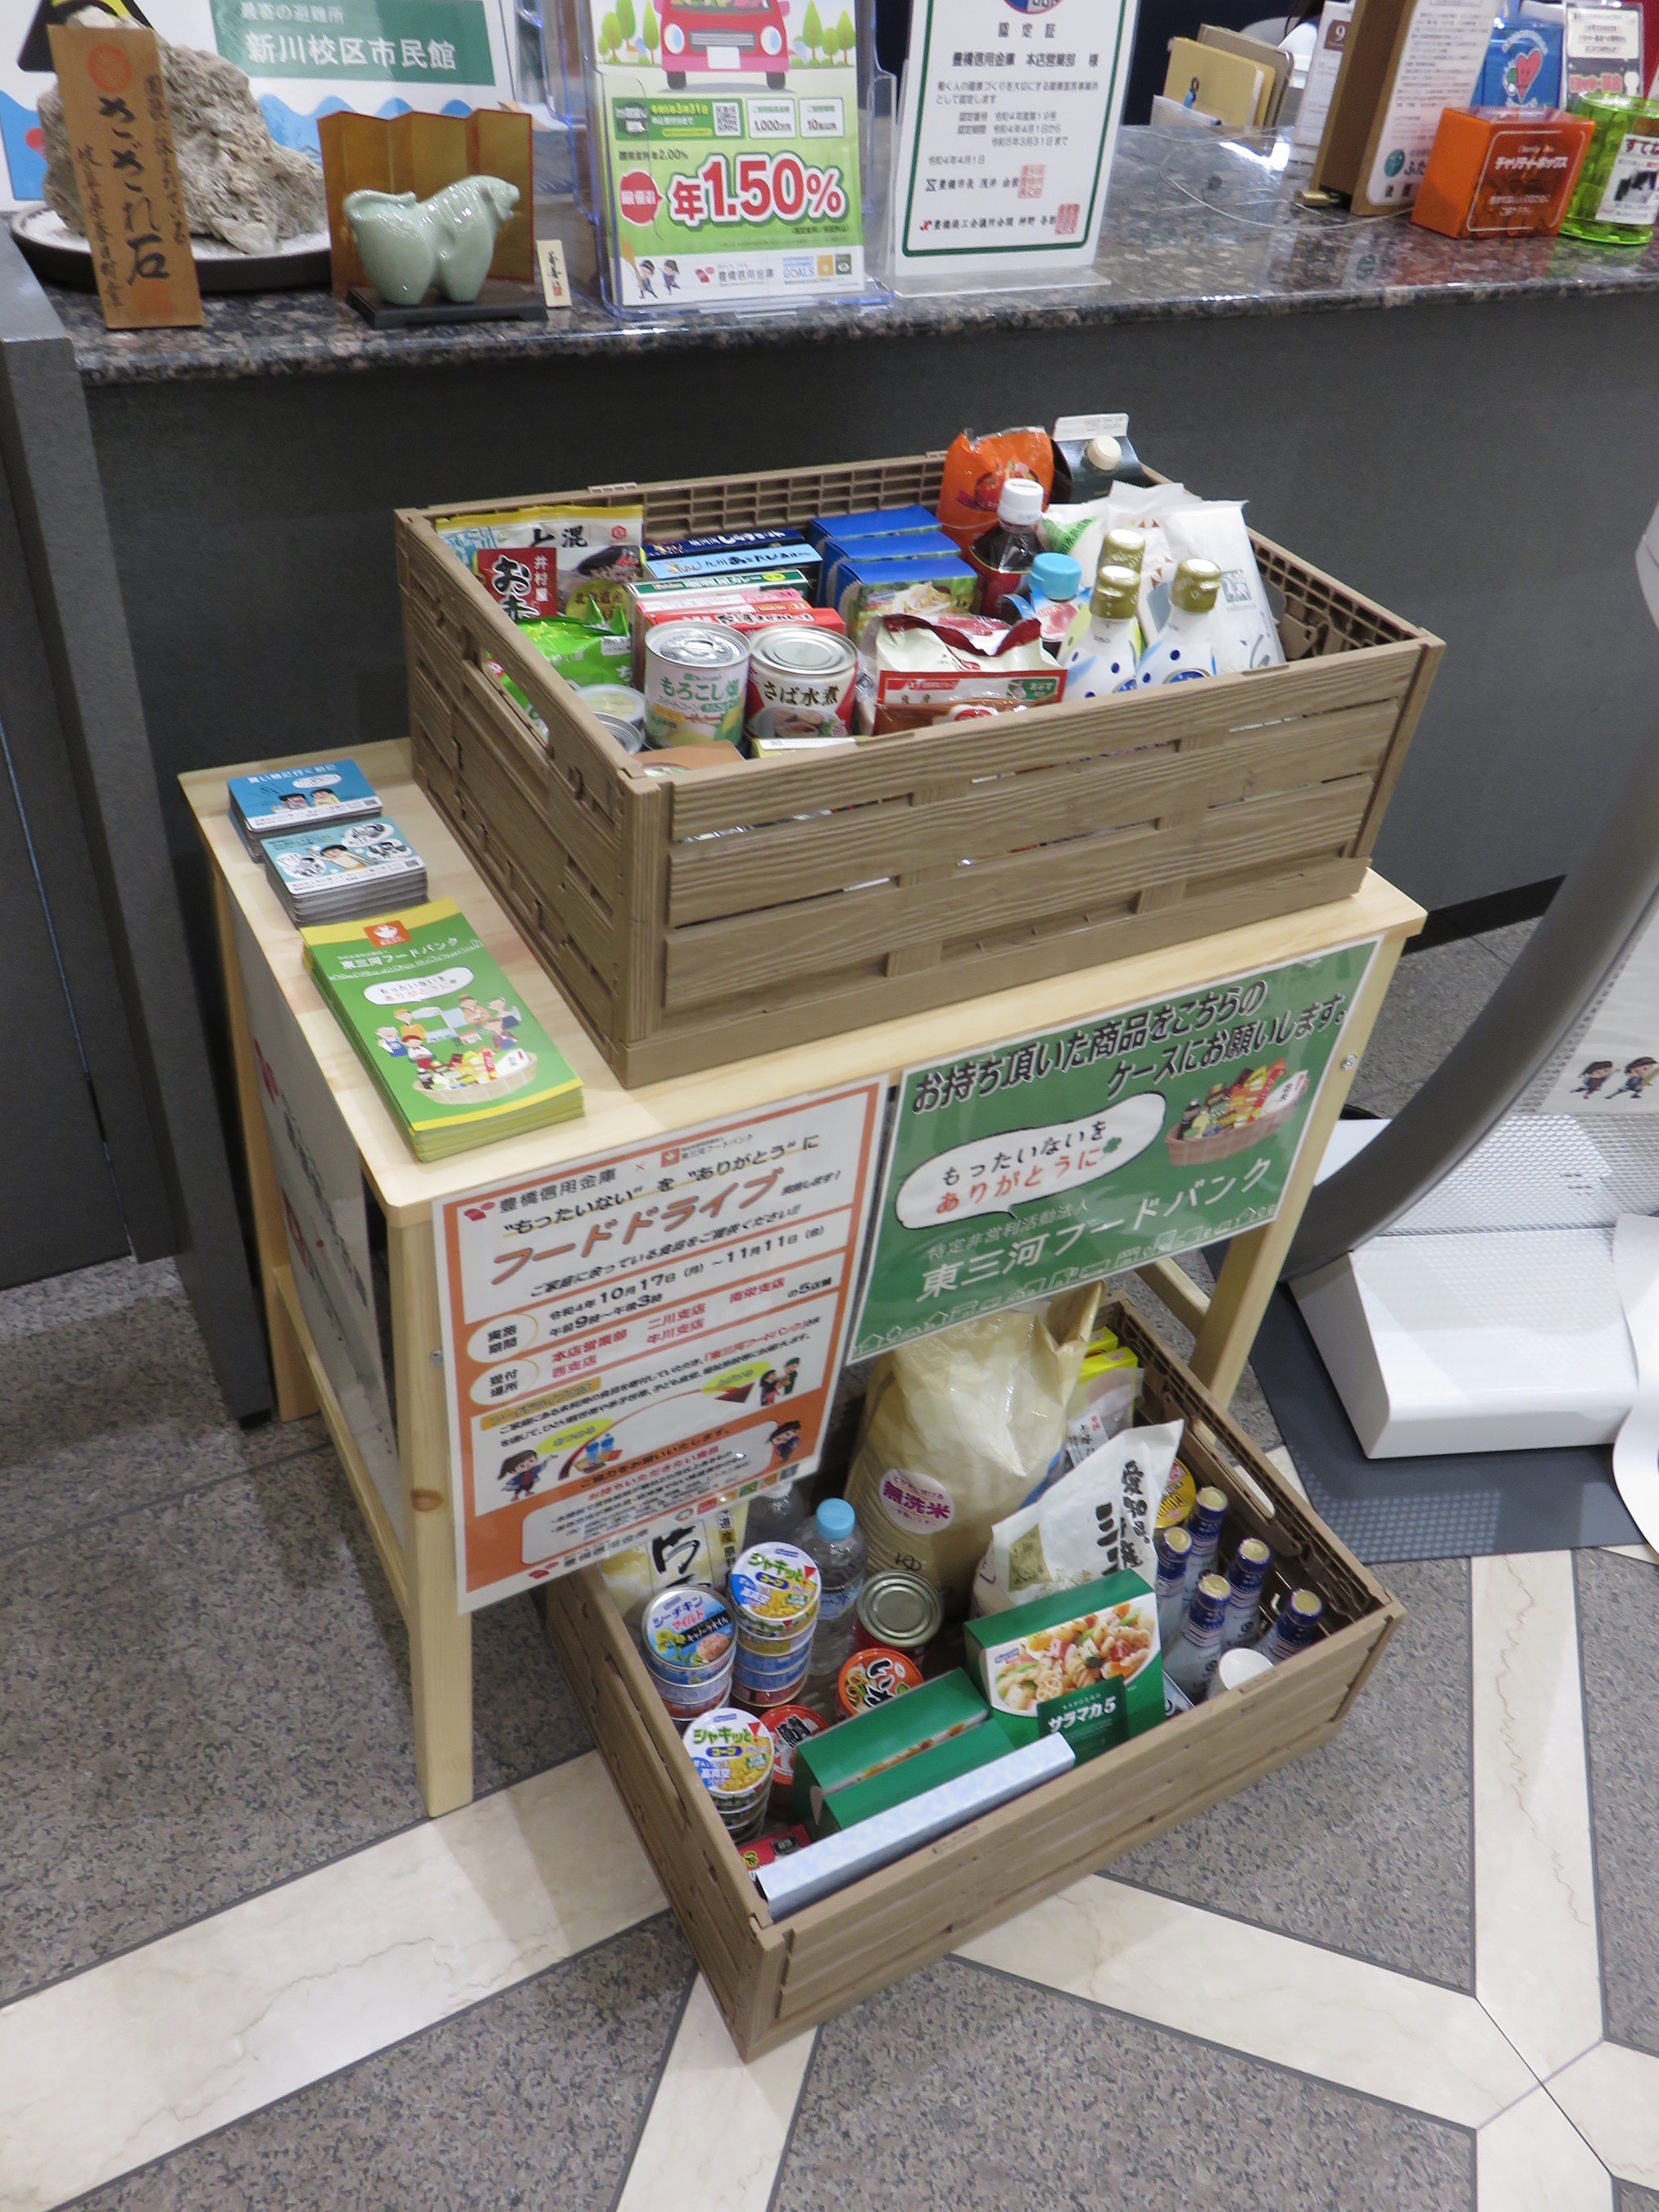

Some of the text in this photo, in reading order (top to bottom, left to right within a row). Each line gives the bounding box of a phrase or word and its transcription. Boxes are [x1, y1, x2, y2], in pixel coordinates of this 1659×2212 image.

[246, 31, 457, 70] 新川校区市民館
[953, 52, 1016, 67] 豊橋信用金庫
[673, 157, 842, 221] 年1.50%
[534, 555, 549, 602] 井村屋
[764, 680, 840, 708] さば水煮
[340, 936, 458, 970] 東三河フードバンク
[912, 980, 1268, 1115] お持ち頂いた商品をこちらの
[1108, 992, 1349, 1100] ケースにお願いします。
[943, 1120, 1106, 1185] もったいないを
[500, 1167, 617, 1214] 豊橋信用金庫
[936, 1148, 1100, 1214] ありがとうに
[491, 1166, 785, 1286] フードドライブ
[915, 1158, 1271, 1303] 東三河フードバンク
[551, 1329, 628, 1363] 本店営業部
[647, 1303, 706, 1330] 二川支店
[552, 1354, 597, 1379] 西支店
[882, 1480, 950, 1520] 無洗米
[652, 1595, 704, 1629] シーチキン
[671, 1608, 705, 1632] マイルド
[1047, 1695, 1117, 1734] サラマカ5
